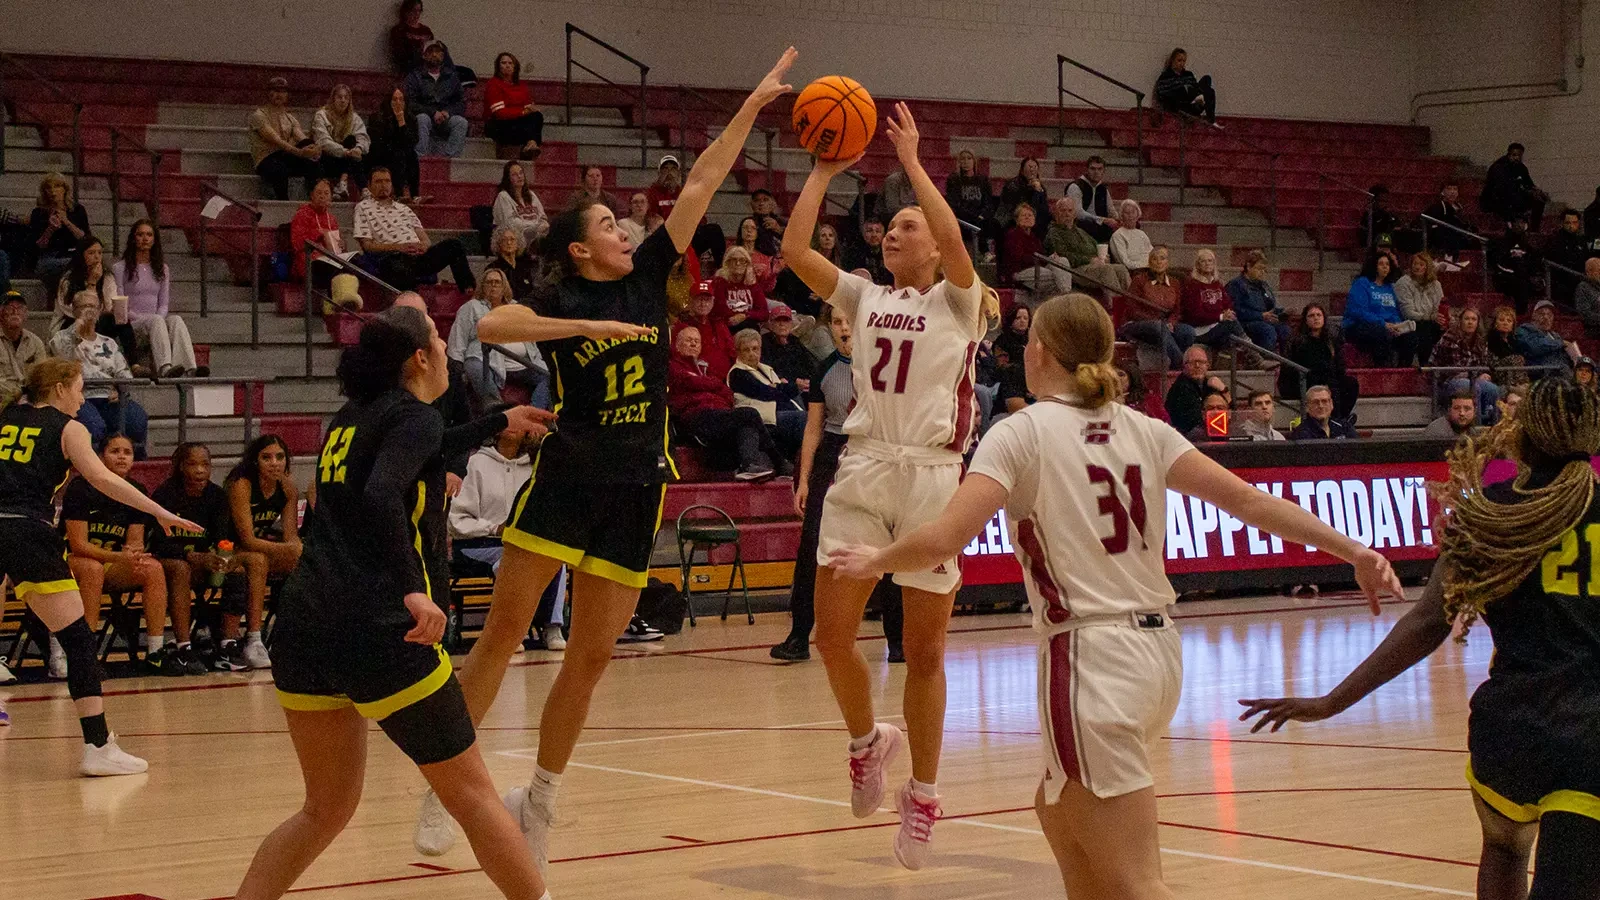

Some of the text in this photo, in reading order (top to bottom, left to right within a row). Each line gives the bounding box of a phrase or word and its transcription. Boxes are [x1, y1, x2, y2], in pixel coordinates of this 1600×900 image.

[603, 354, 645, 402] 12
[870, 336, 914, 394] 21
[0, 425, 42, 464] 25
[319, 425, 356, 484] 42
[1086, 464, 1148, 554] 31
